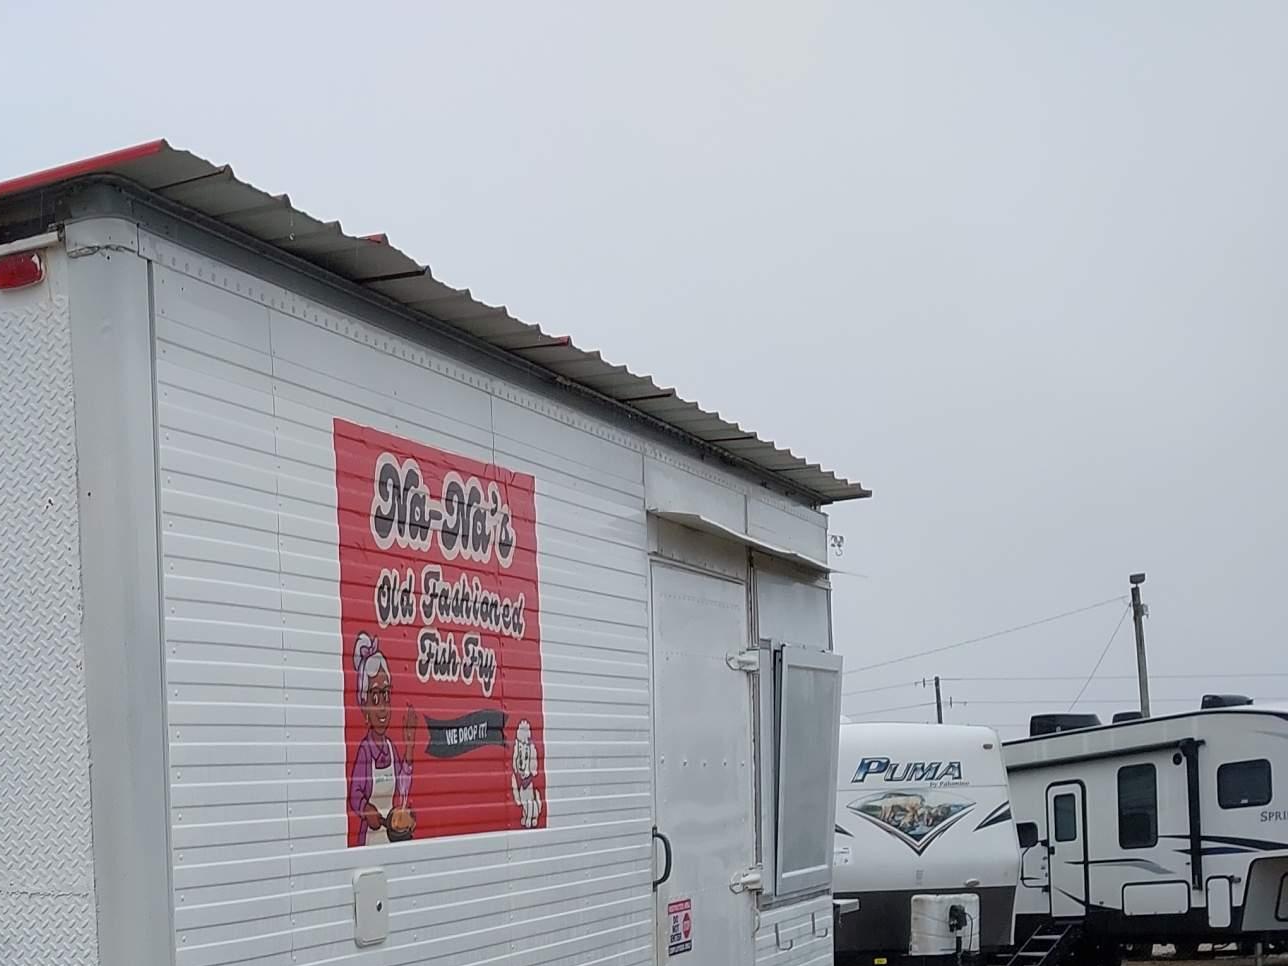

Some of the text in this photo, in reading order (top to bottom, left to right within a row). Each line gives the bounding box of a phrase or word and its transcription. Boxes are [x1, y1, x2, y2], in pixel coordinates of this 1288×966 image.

[374, 456, 515, 563] Na-Na's
[376, 567, 525, 637] Old Fashioned
[417, 629, 495, 695] Fish Fry
[445, 728, 458, 746] WE
[458, 724, 478, 744] DROP
[851, 757, 963, 783] PUMA
